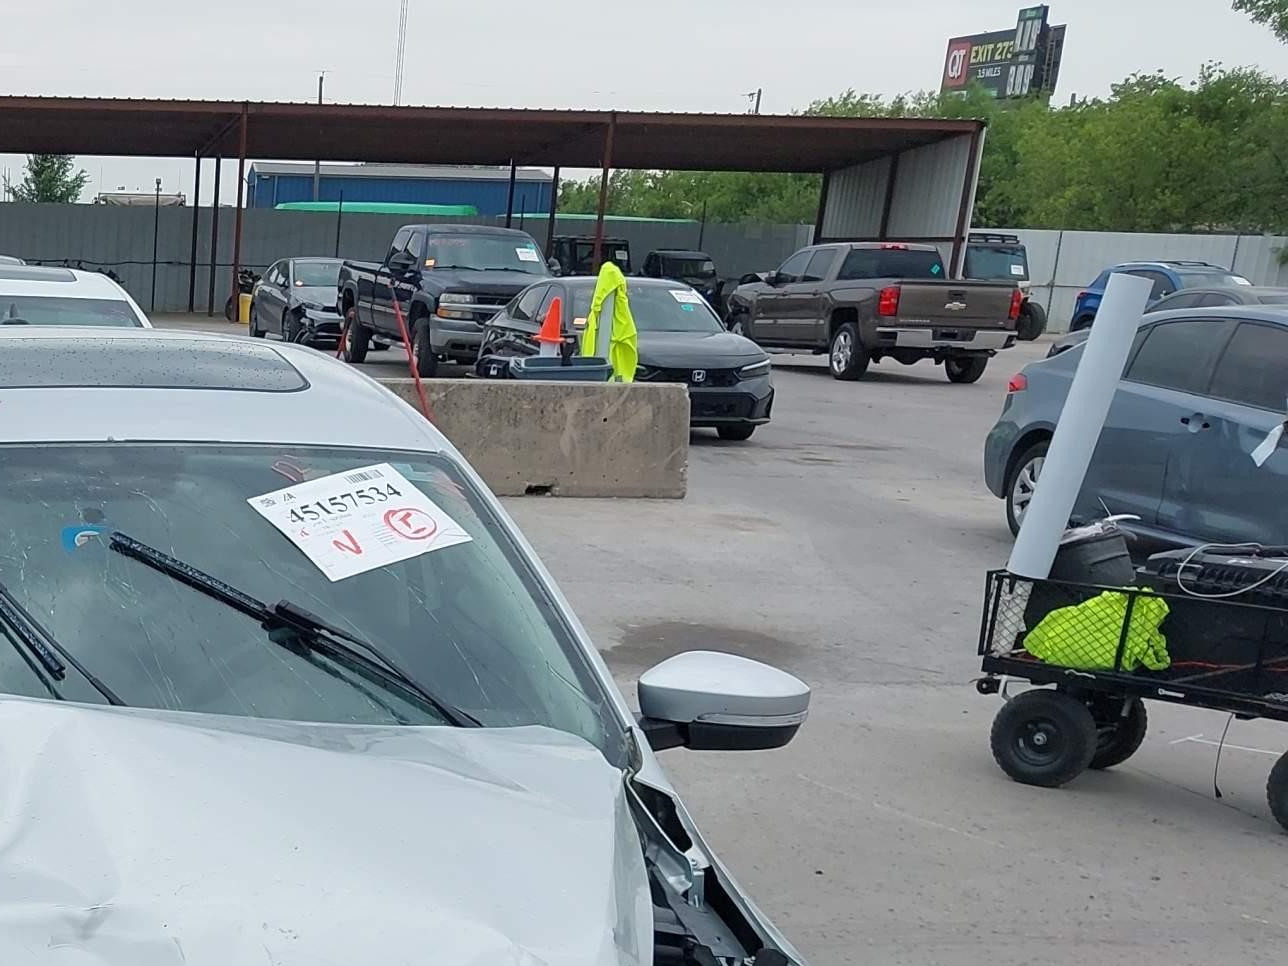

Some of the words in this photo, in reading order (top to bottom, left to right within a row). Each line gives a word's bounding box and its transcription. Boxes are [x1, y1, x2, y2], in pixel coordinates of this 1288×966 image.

[948, 49, 967, 78] QT
[970, 42, 994, 63] EXIT
[289, 482, 403, 524] 45157534
